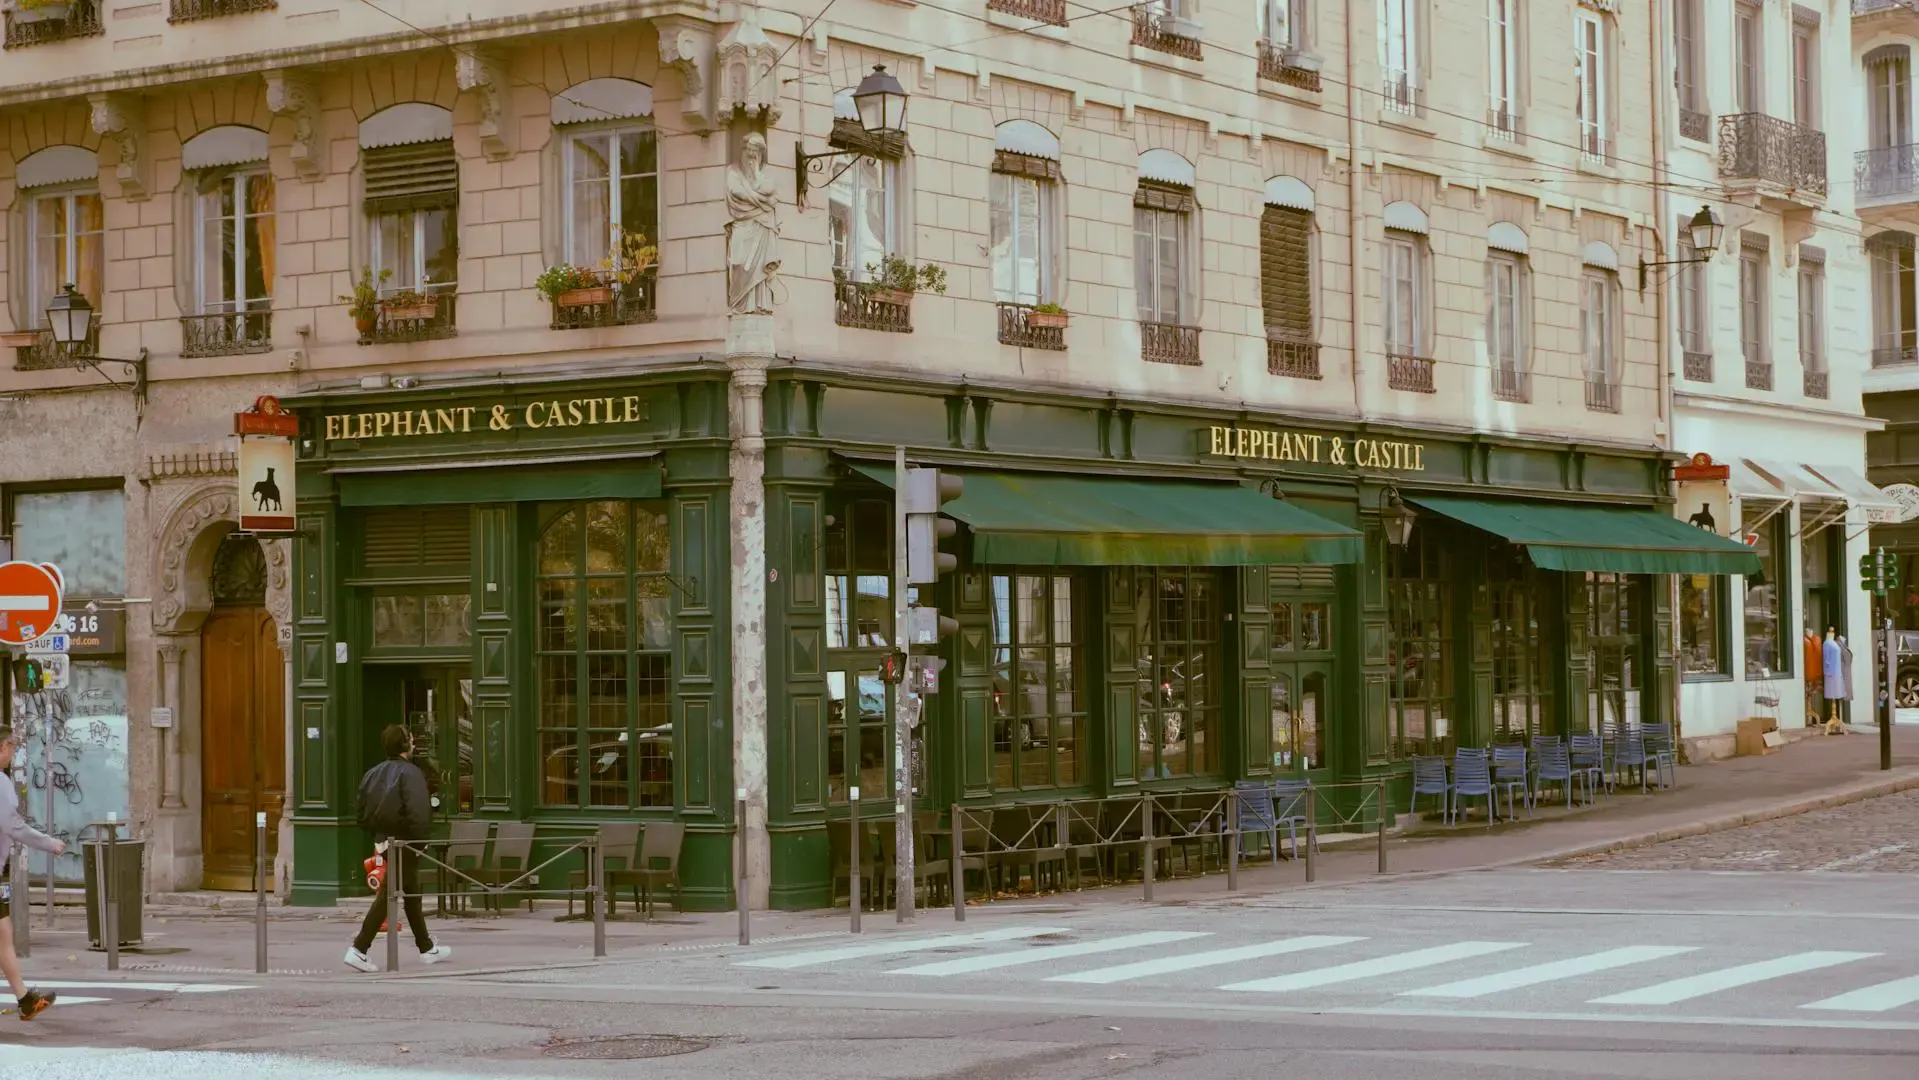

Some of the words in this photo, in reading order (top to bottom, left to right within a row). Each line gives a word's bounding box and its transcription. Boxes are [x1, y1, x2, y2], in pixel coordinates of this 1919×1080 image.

[325, 407, 476, 440] ELEPHANT
[489, 404, 513, 430] &
[525, 396, 640, 429] CASTLE
[1210, 426, 1322, 463] ELEPHANT
[1330, 437, 1346, 465] &
[1355, 439, 1424, 470] CASTLE
[80, 616, 98, 632] 16
[281, 628, 291, 639] 16
[28, 639, 51, 648] SAUF
